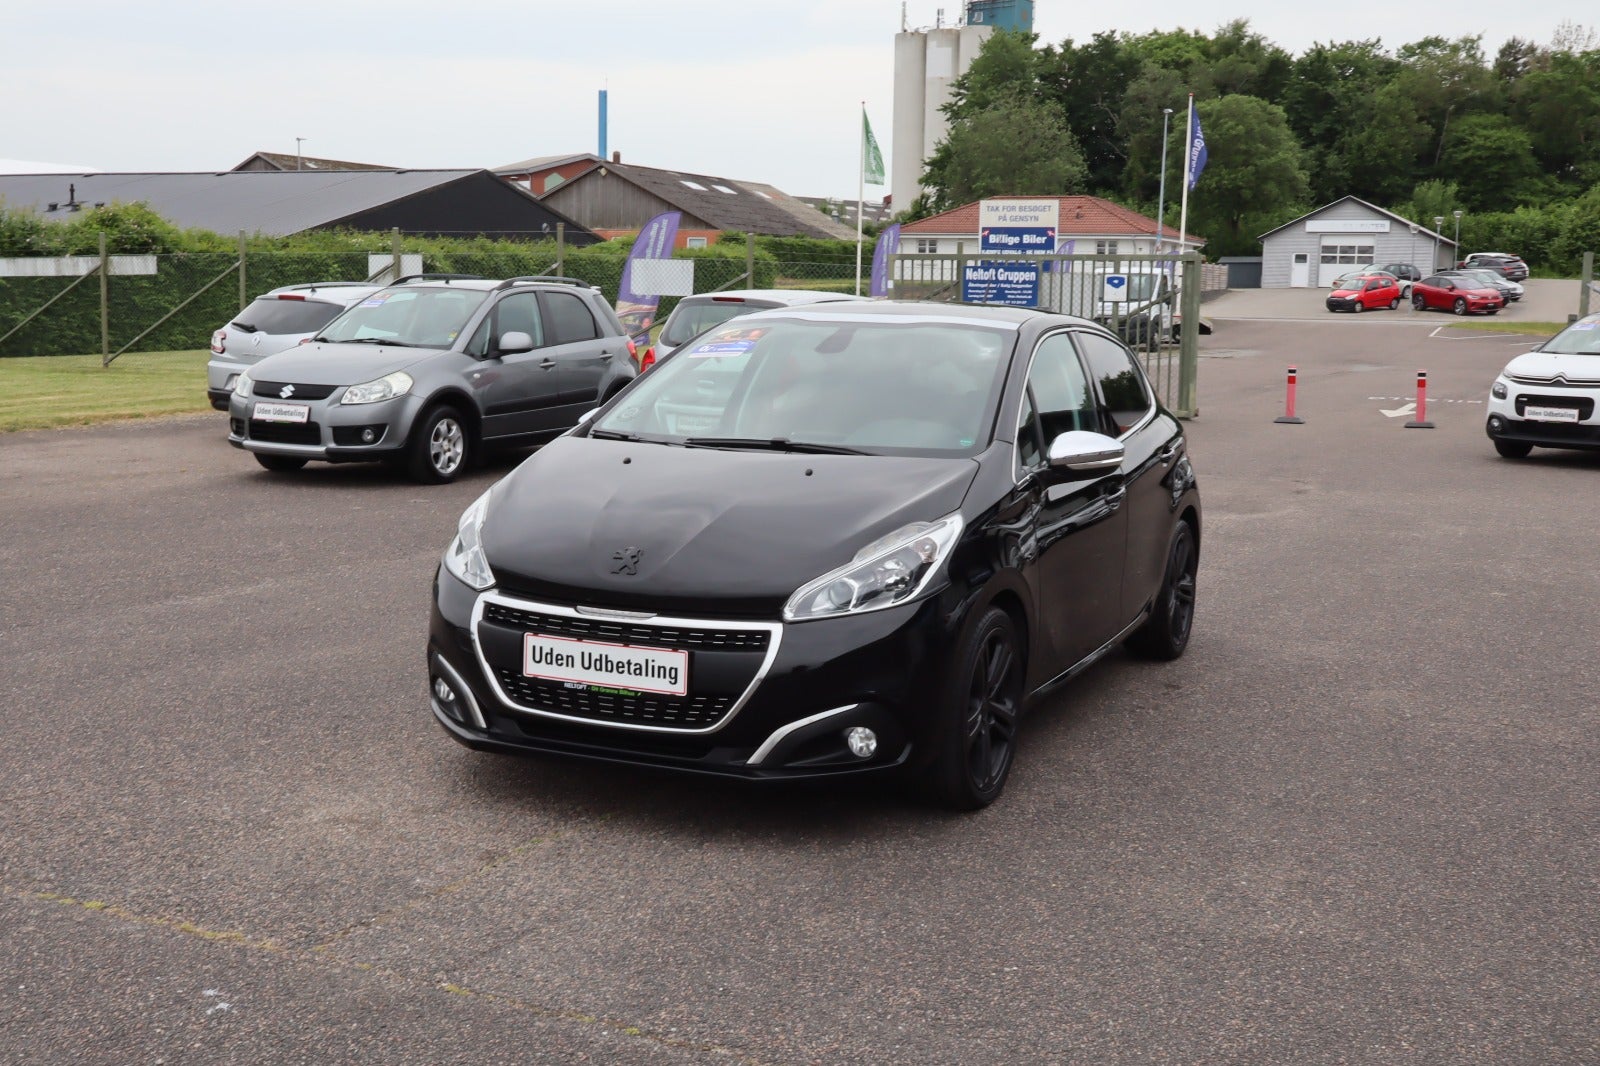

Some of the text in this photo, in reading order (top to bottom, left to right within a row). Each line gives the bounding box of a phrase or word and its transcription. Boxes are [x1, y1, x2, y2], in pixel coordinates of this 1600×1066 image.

[986, 205, 1052, 213] TAK FOR BESØGET
[998, 214, 1008, 222] PÅ
[989, 234, 1047, 246] Billige Biler
[966, 268, 1036, 283] Neltoft Gruppen
[256, 406, 306, 419] Uden Udbetaling
[1543, 410, 1576, 419] Udbetaling
[532, 644, 679, 686] Uden Udbetaling
[563, 682, 587, 691] NELTOFT
